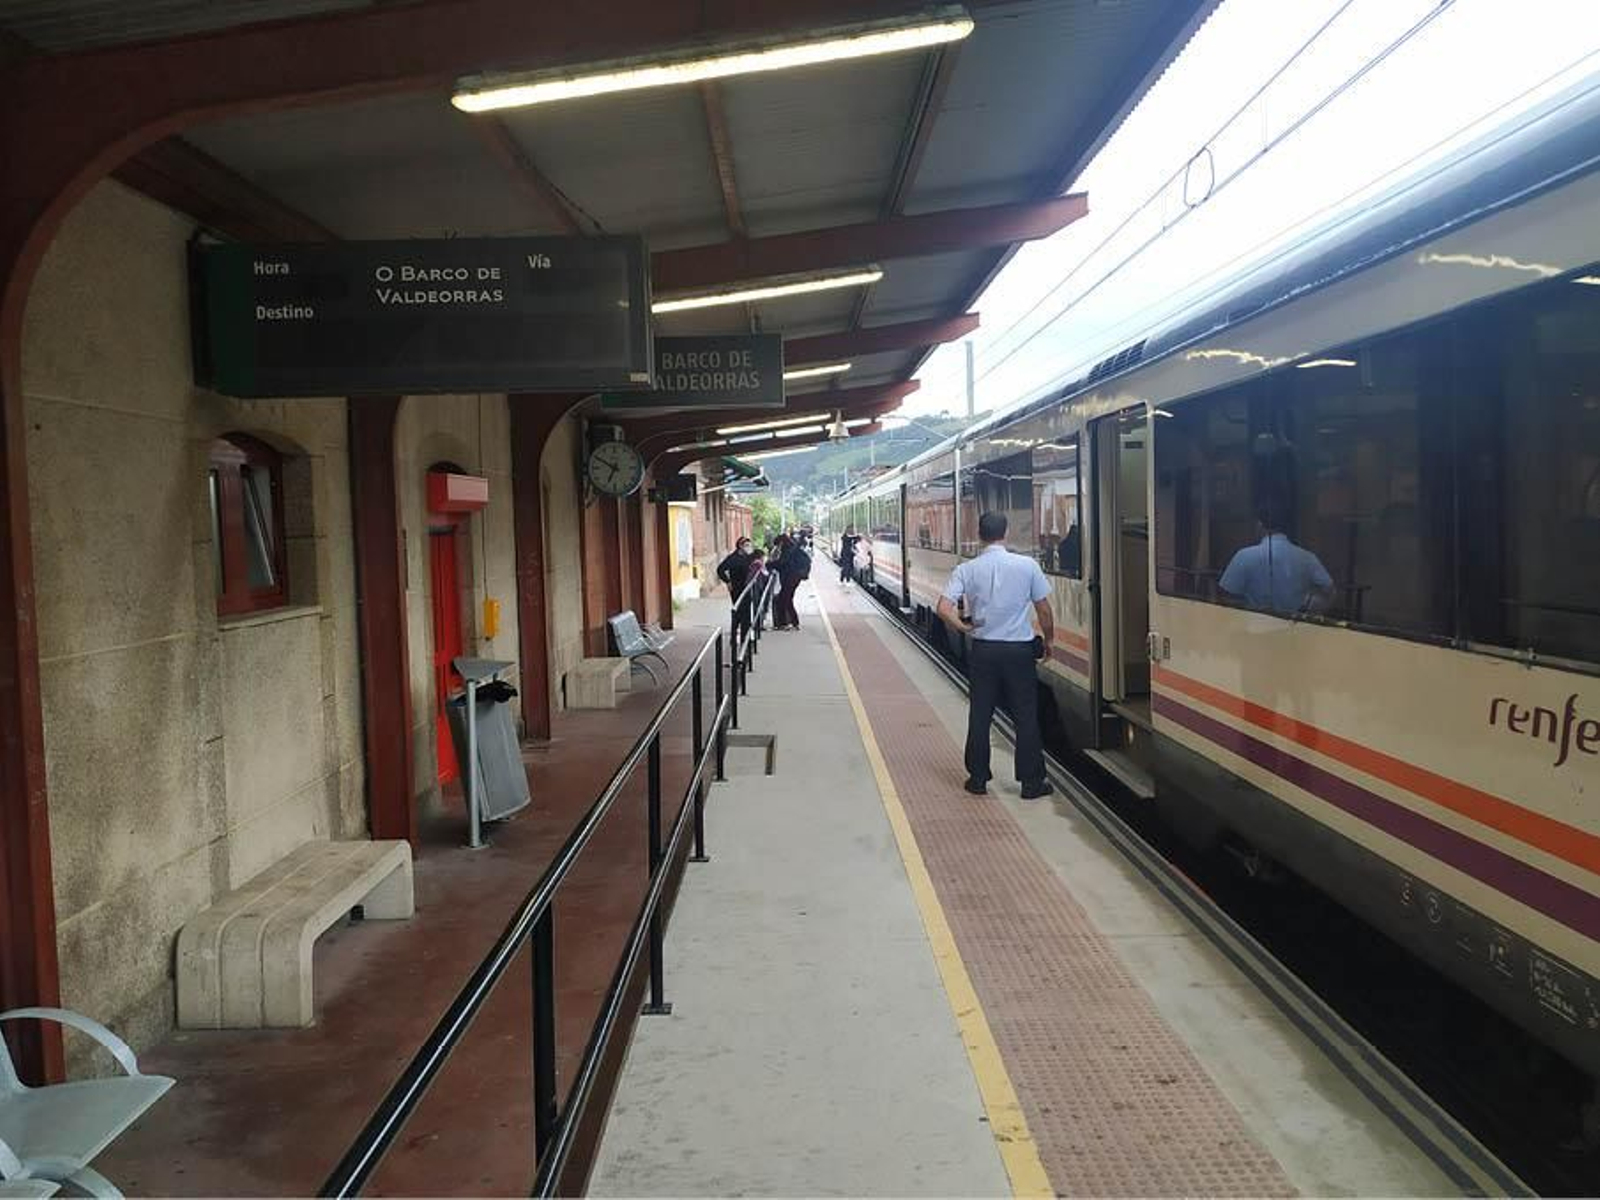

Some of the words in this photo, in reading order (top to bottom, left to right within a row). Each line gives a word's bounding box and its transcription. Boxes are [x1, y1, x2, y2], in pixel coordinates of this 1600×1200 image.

[253, 260, 290, 276] Hora
[527, 254, 552, 269] Vía
[375, 266, 394, 282] O
[255, 304, 315, 320] Destino
[662, 352, 721, 370] BARCO
[729, 351, 752, 367] DE
[655, 371, 760, 391] ALDEORRAS
[1489, 693, 1600, 767] renfe
